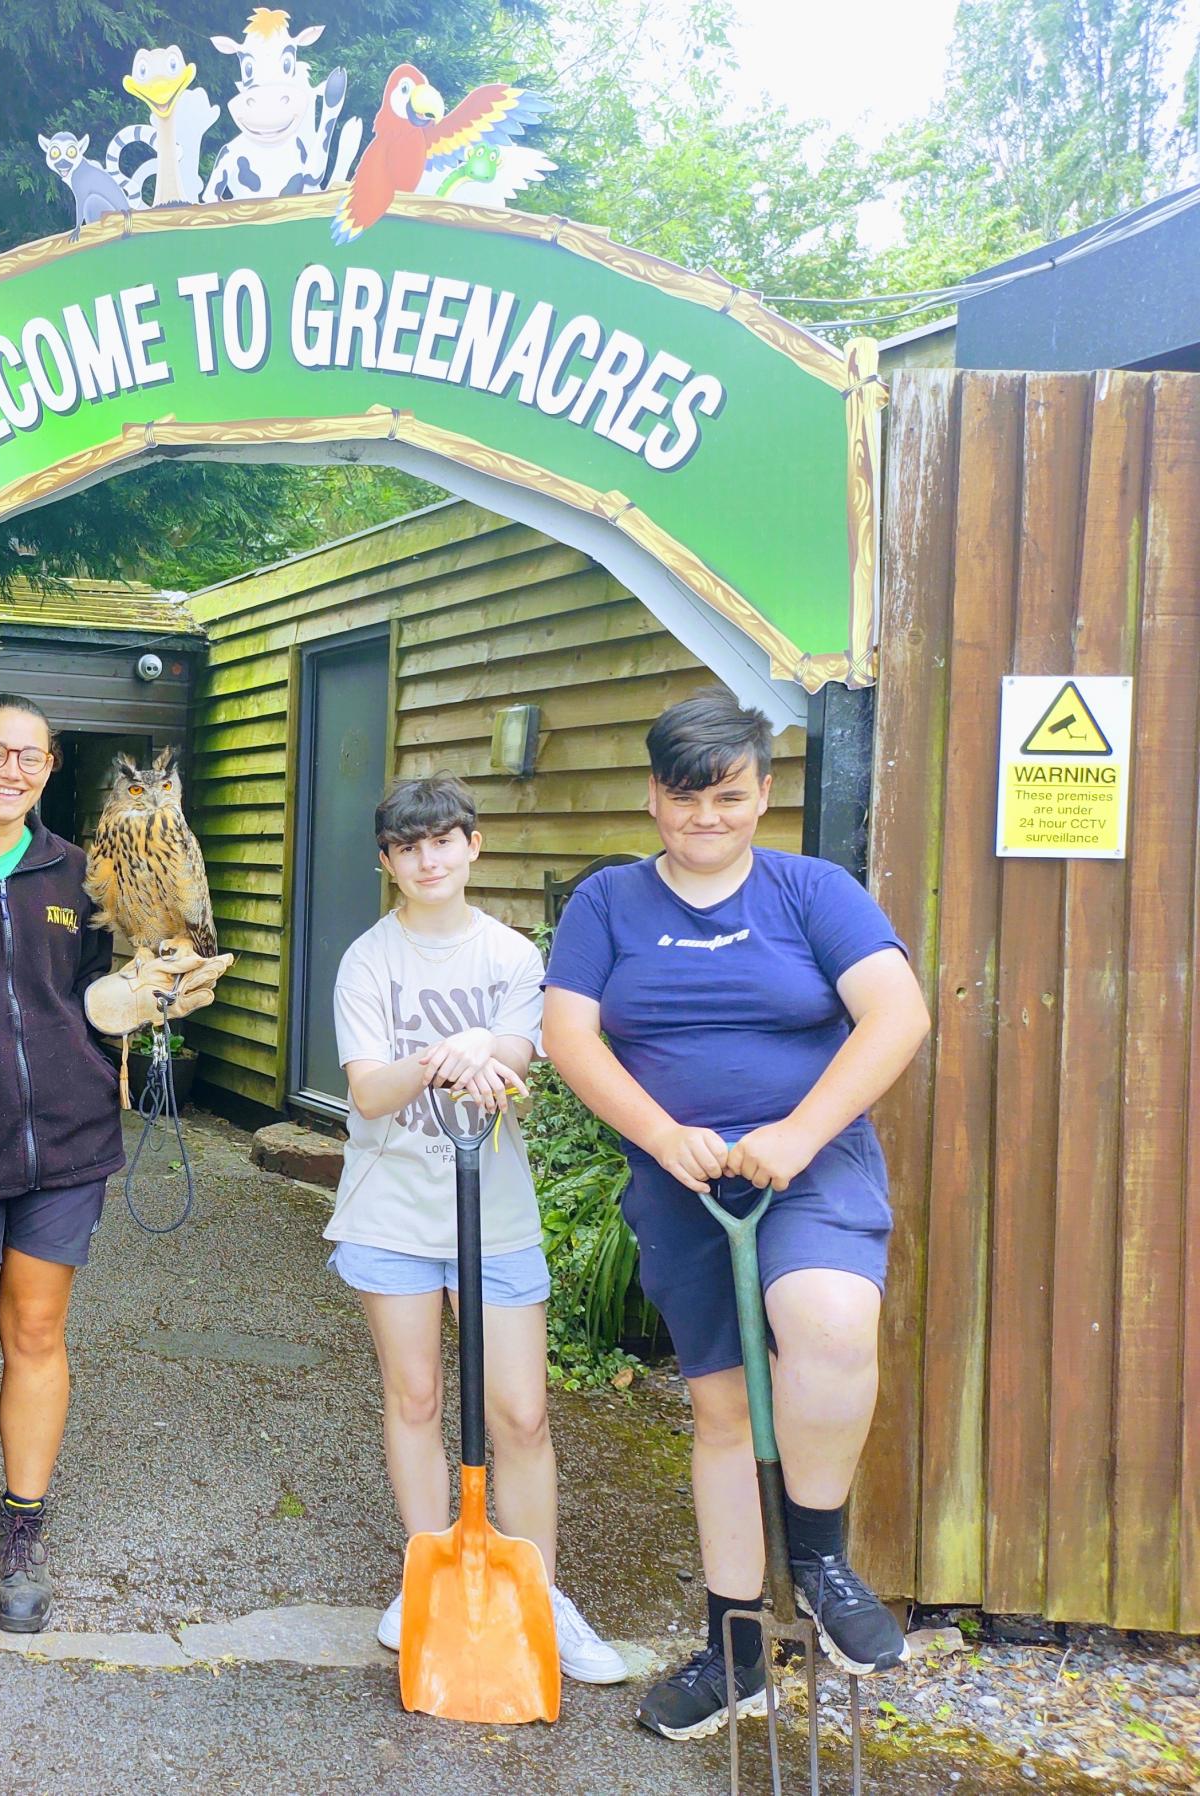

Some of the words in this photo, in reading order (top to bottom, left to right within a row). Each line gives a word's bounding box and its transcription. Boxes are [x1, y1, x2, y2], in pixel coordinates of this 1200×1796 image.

[177, 268, 268, 373] TO
[291, 264, 724, 470] GREENACRES
[1014, 766, 1116, 783] WARNING
[1015, 790, 1053, 801] These
[1057, 791, 1113, 803] premises
[1033, 806, 1053, 815] are
[1057, 804, 1093, 815] under
[1019, 817, 1034, 828] 24
[1039, 818, 1067, 829] hour
[1070, 818, 1107, 829] CCTV
[1026, 832, 1099, 843] surveillance
[425, 1144, 452, 1154] LOVE
[442, 1154, 456, 1164] FA
